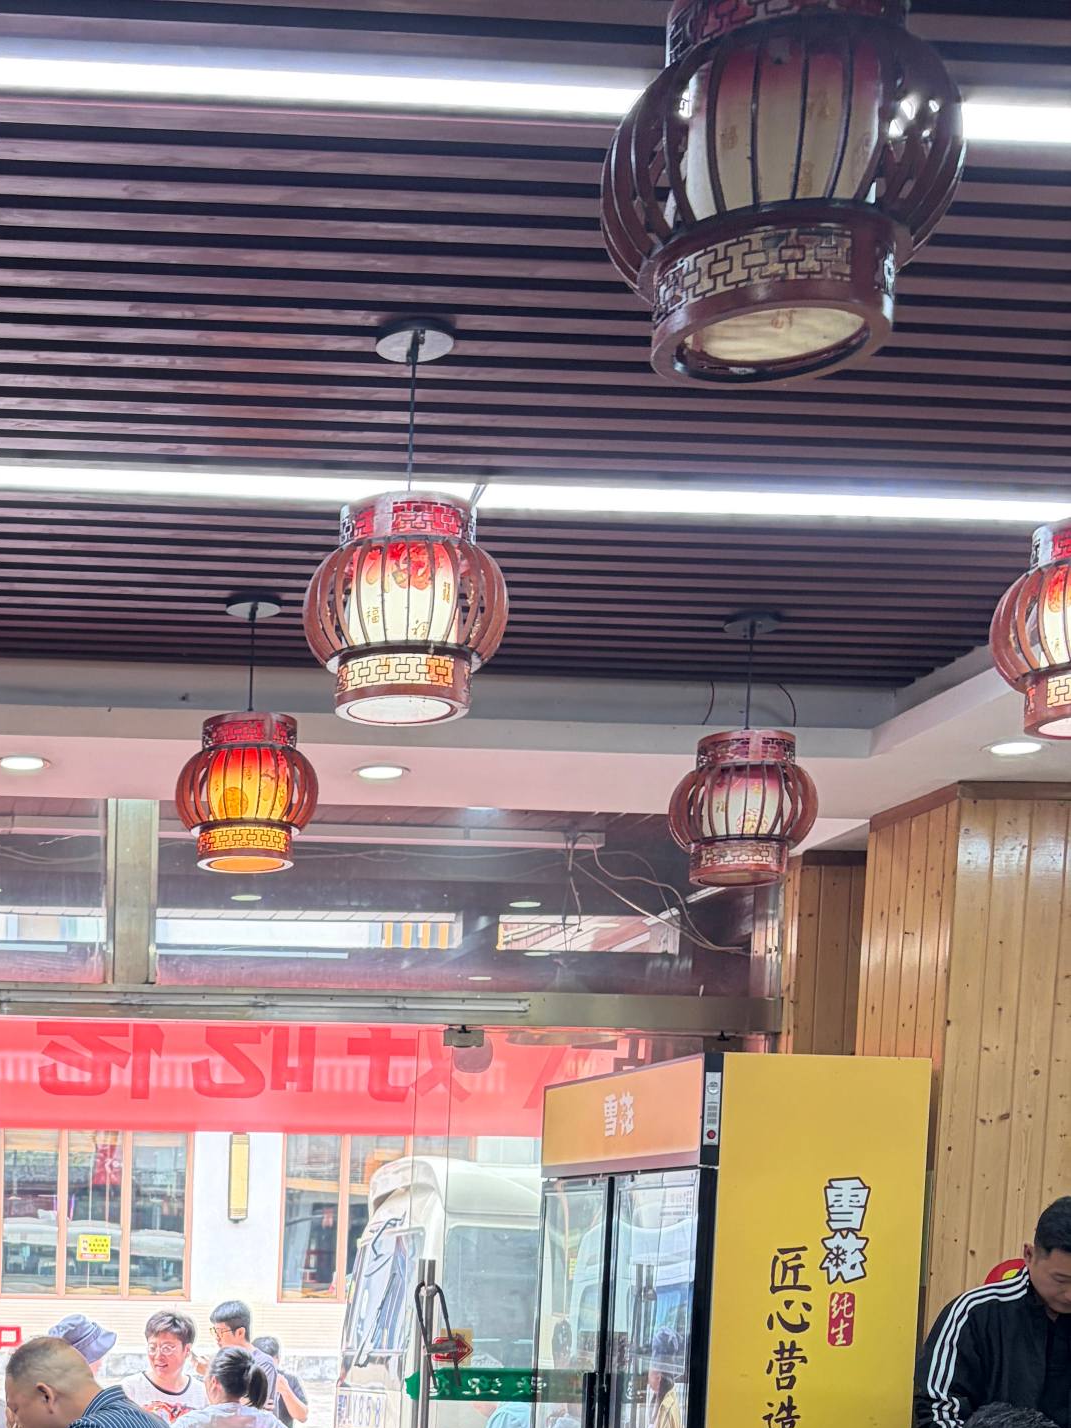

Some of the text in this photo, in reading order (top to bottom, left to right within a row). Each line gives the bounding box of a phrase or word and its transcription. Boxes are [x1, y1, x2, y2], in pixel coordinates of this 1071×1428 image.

[603, 1092, 635, 1137] 雪花
[819, 1176, 871, 1284] 雪花
[830, 1294, 854, 1345] 纯生
